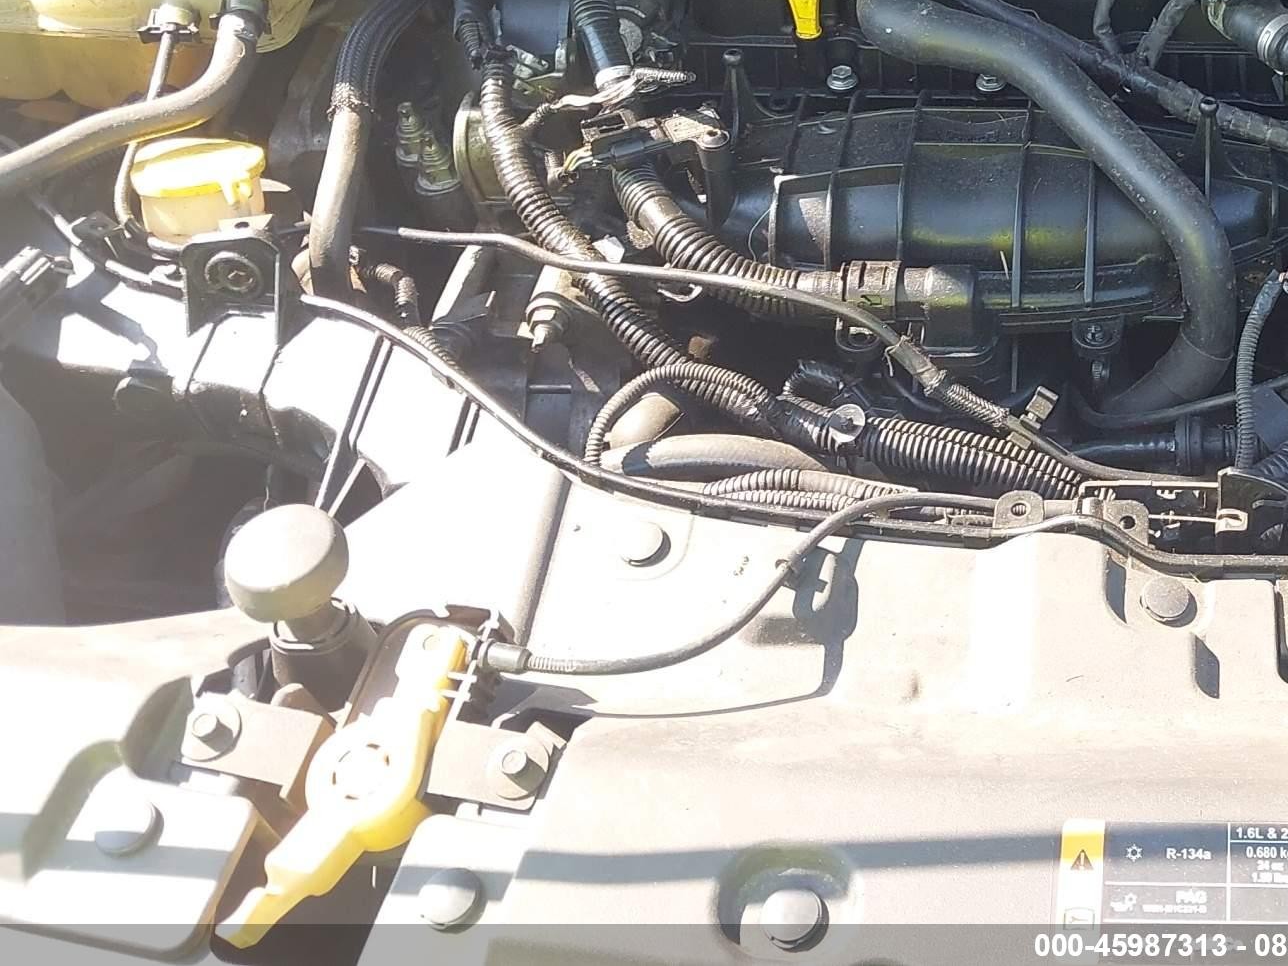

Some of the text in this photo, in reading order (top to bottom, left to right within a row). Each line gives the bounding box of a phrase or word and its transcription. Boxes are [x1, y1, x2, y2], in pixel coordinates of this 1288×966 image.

[1236, 827, 1264, 839] 1.6L
[1266, 827, 1278, 840] &
[1166, 848, 1212, 860] R-134a
[1246, 846, 1278, 859] 0.680
[1256, 860, 1284, 871] 24 oz
[1176, 891, 1208, 904] PAG
